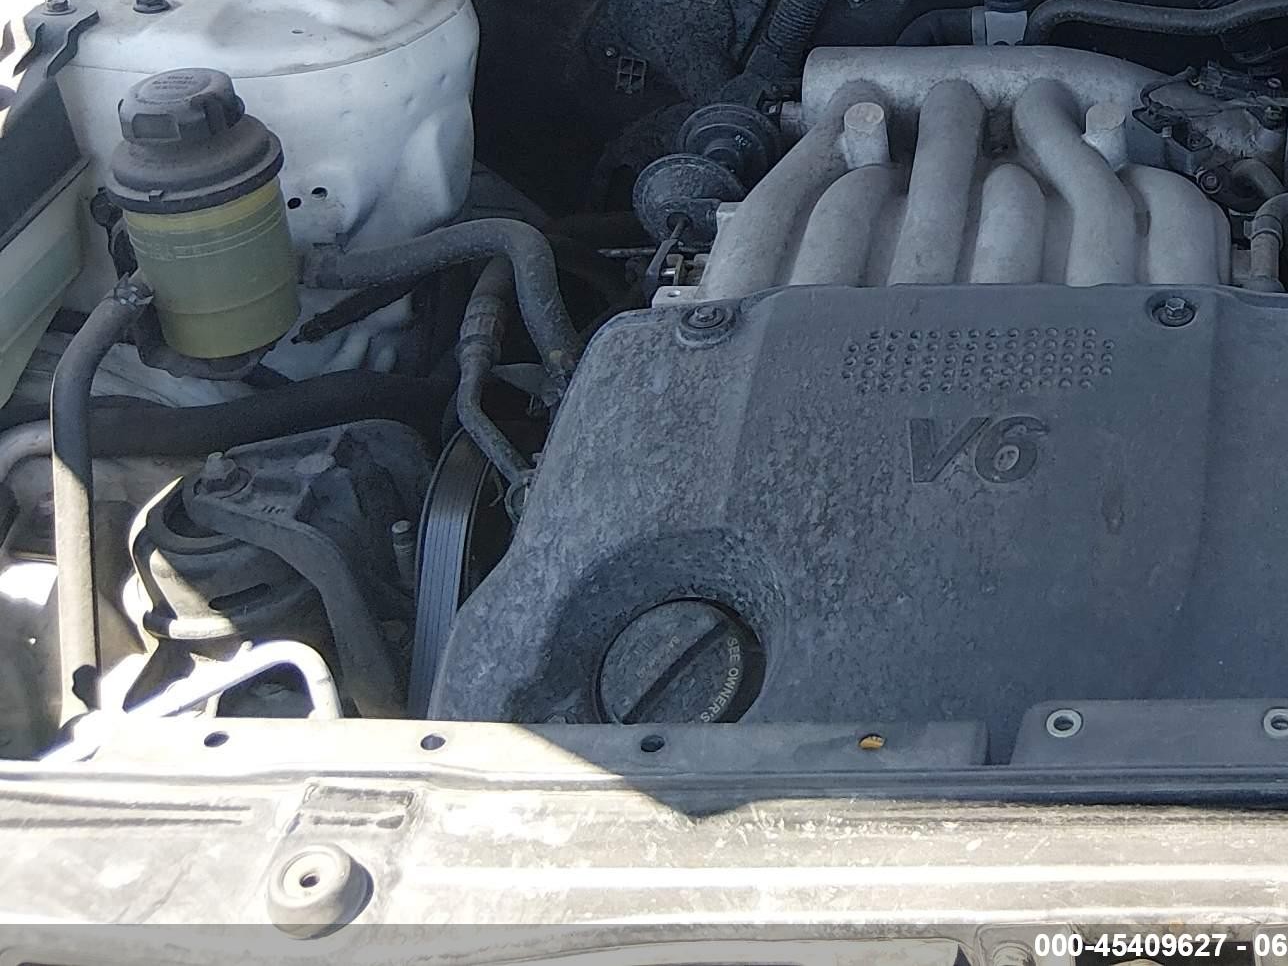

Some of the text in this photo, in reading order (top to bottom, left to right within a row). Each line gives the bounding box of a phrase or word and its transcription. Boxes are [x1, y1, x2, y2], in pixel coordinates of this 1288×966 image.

[908, 414, 1050, 484] V6
[700, 636, 741, 723] SEE OWNER'S
